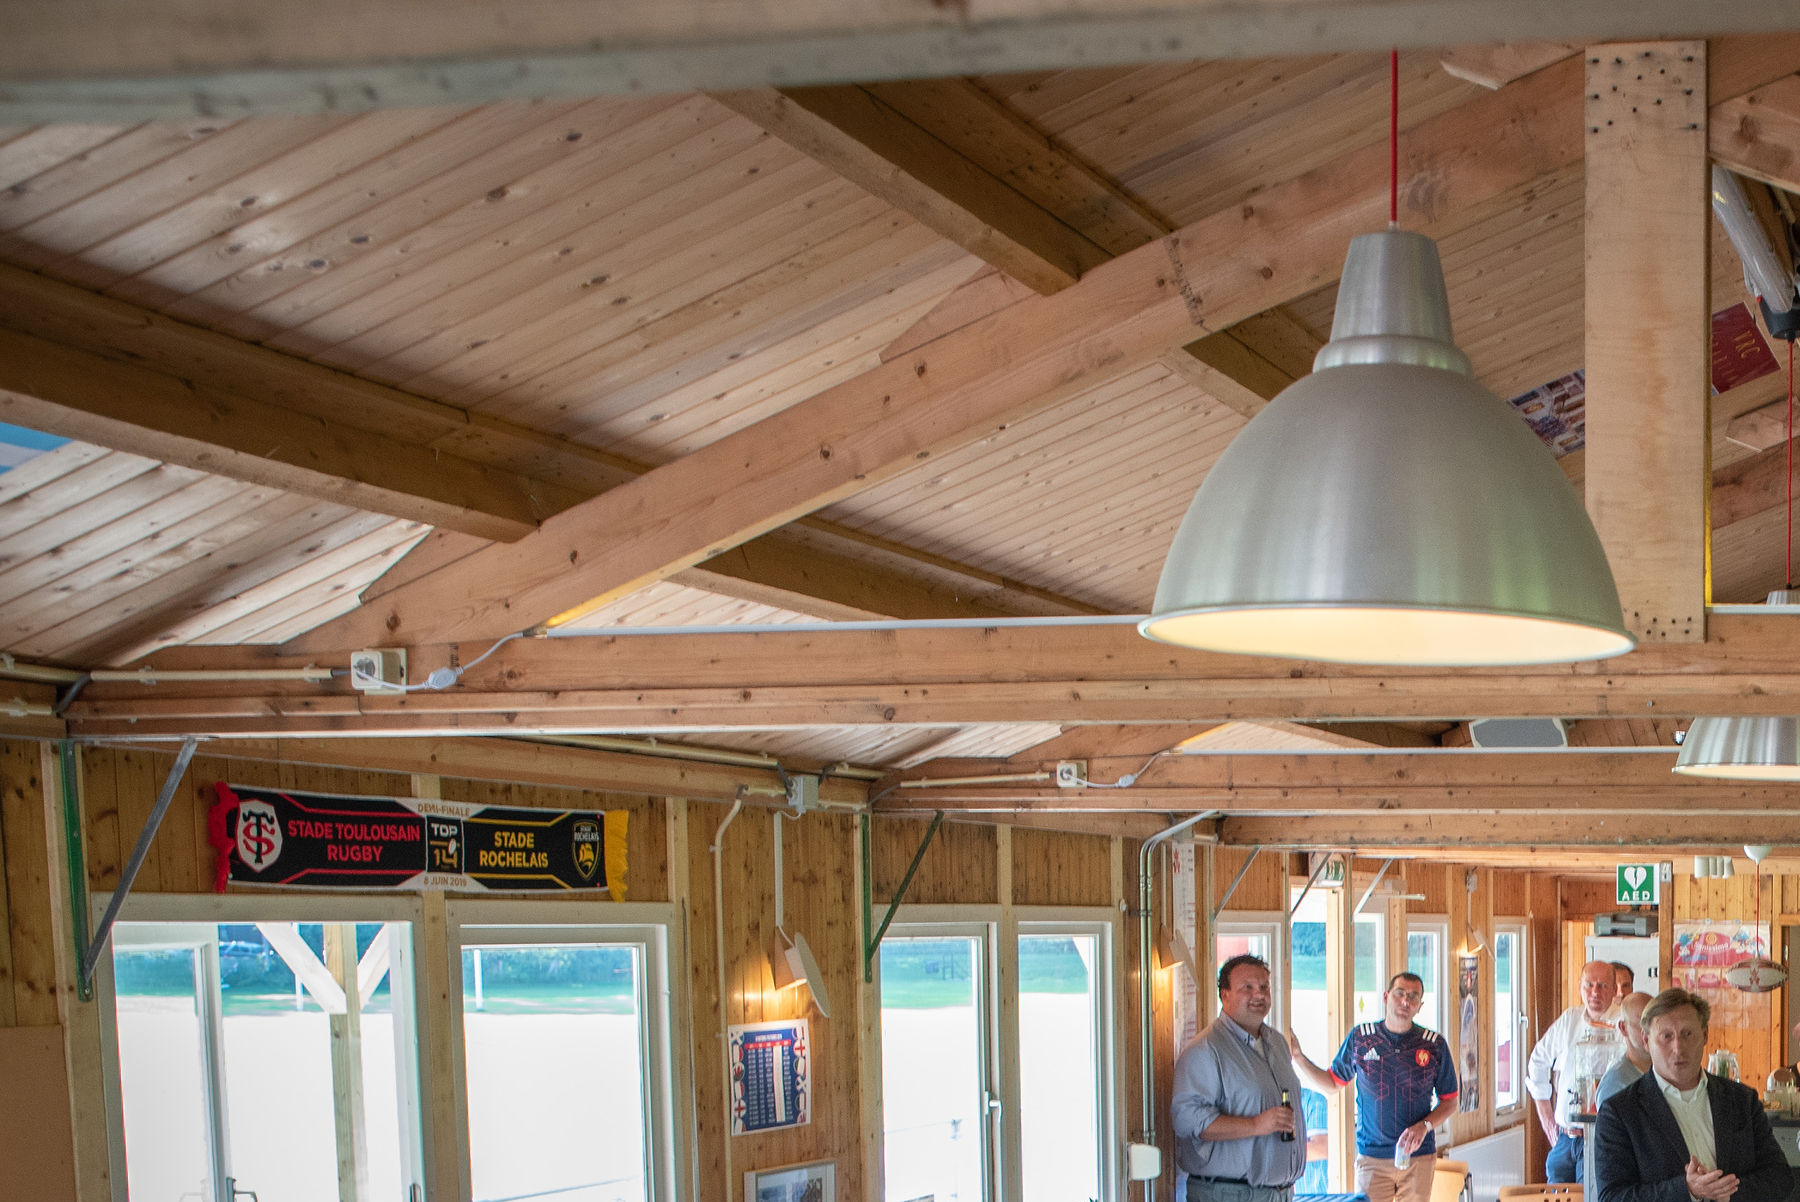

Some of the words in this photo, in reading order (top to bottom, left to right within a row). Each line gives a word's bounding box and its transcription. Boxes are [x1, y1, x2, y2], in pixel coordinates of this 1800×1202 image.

[417, 803, 471, 817] DEMI-FINALE
[288, 819, 333, 840] STADE
[335, 821, 420, 842] TOULOUSAIN
[430, 823, 458, 838] TOP
[494, 831, 534, 849] STADE
[327, 843, 383, 862] RUGBY
[433, 848, 458, 869] 14
[479, 851, 548, 869] ROCHELAIS
[430, 876, 448, 887] JUIN
[1622, 890, 1650, 902] AED
